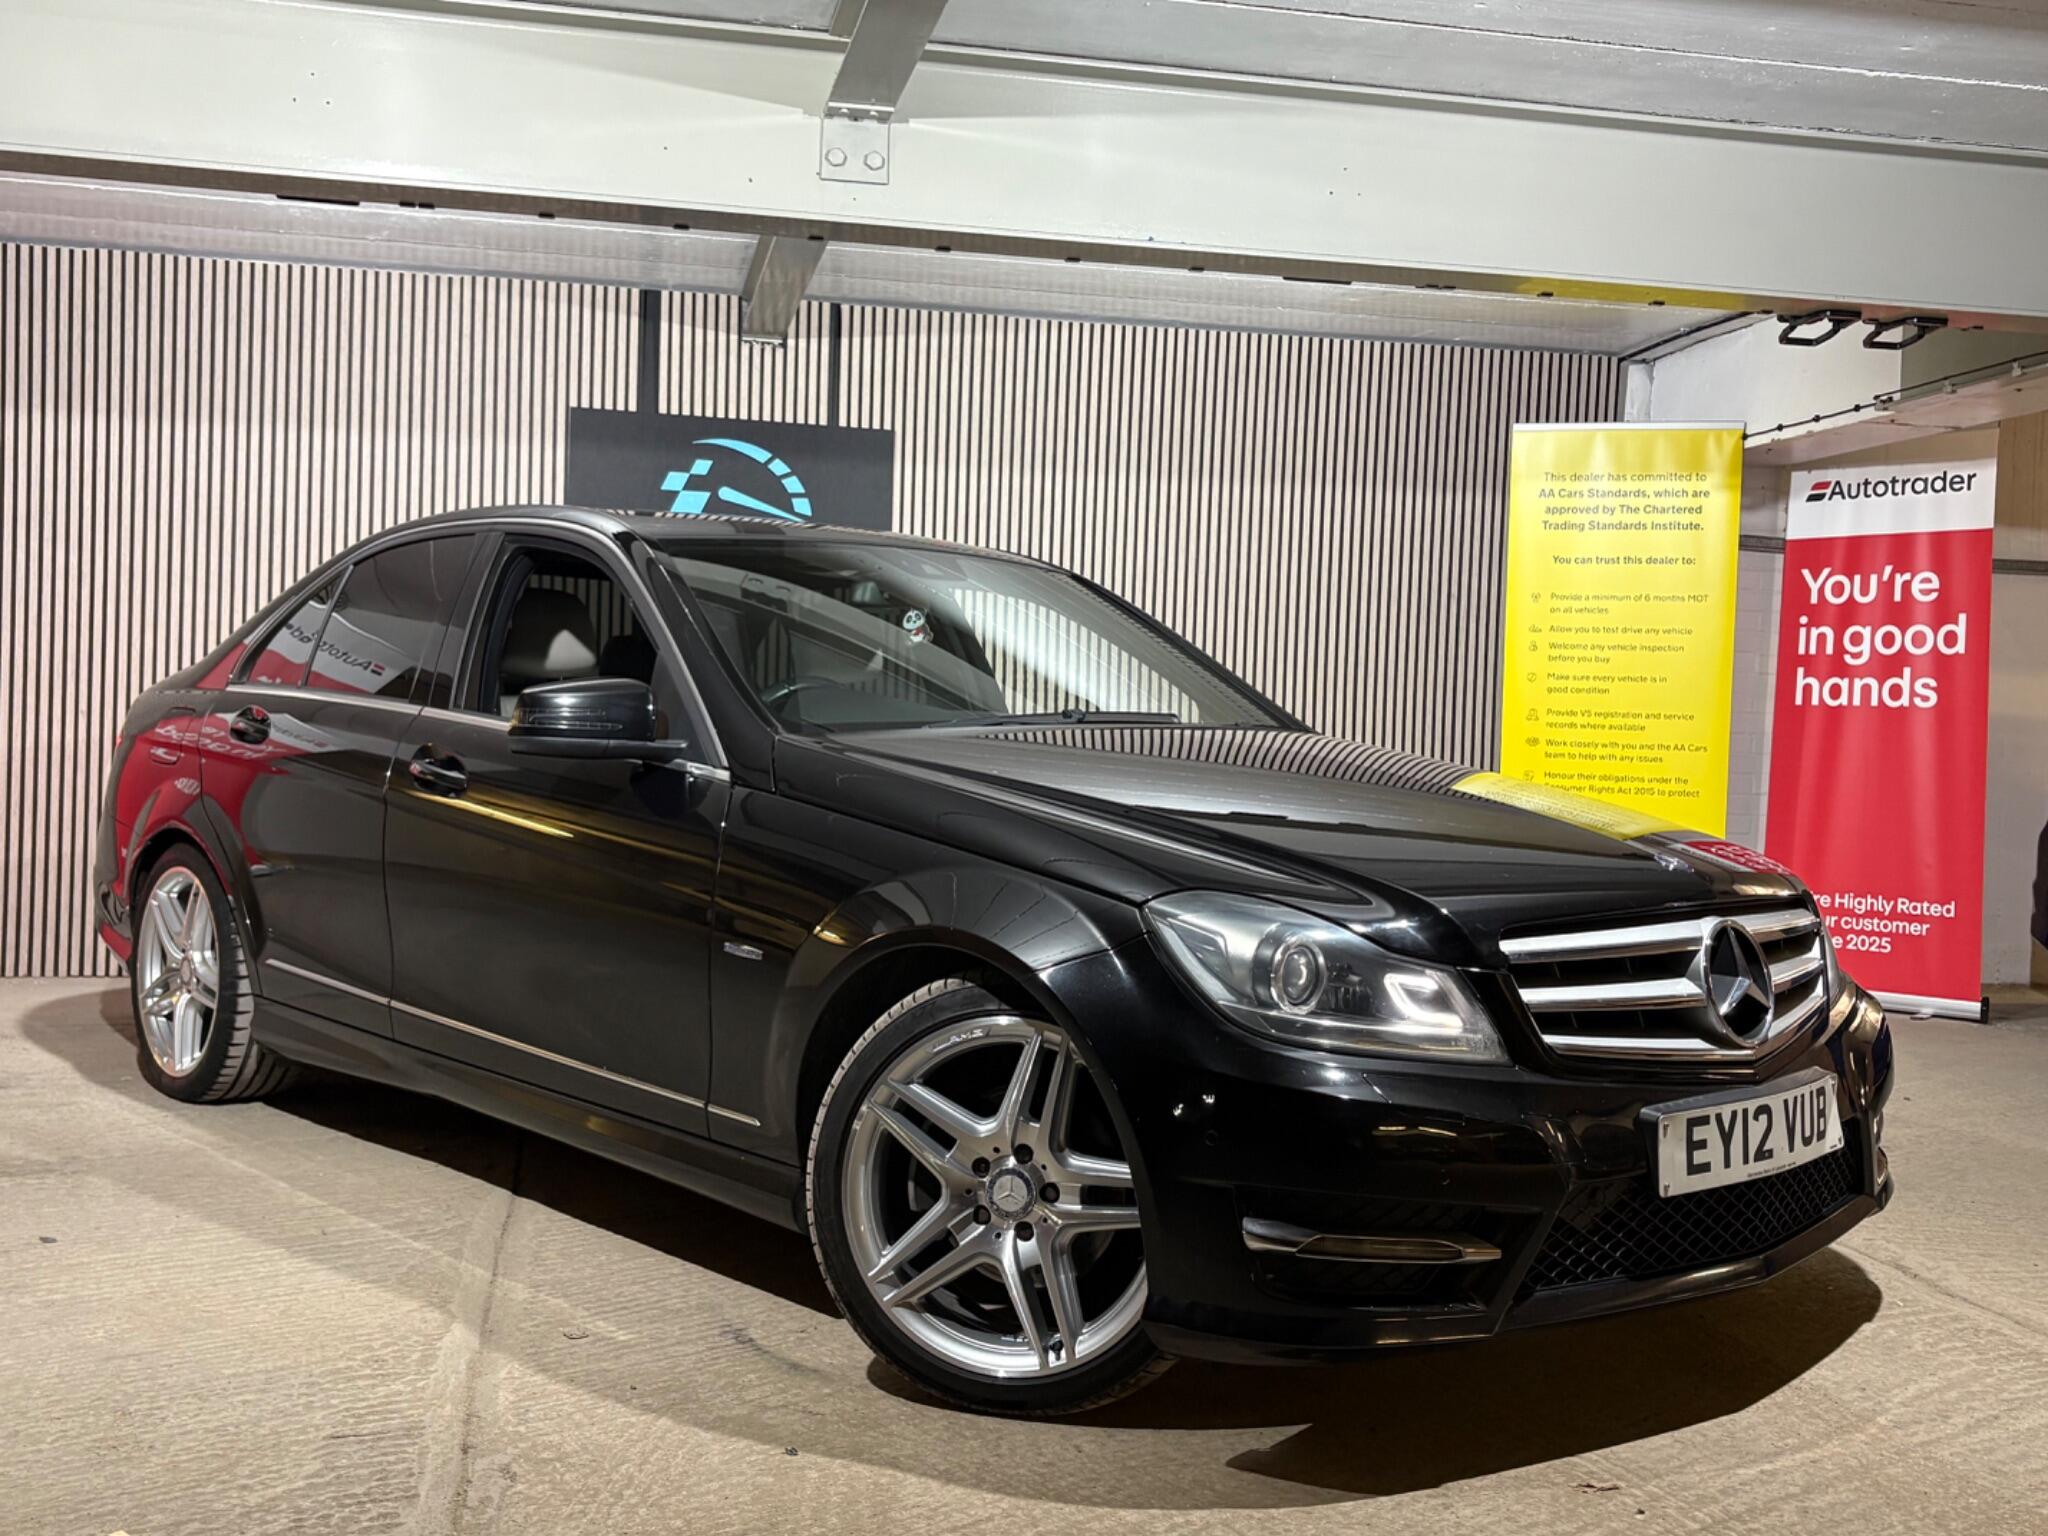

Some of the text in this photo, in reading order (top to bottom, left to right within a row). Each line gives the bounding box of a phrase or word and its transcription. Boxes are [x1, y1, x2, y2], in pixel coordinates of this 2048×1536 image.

[1544, 472, 1707, 482] This dealer has committed to
[1828, 471, 1976, 501] Autotrader
[1538, 488, 1710, 498] AA Cars Standards, which are
[1544, 504, 1702, 515] approved by The Chartered
[1542, 520, 1703, 531] Trading Standards Institute.
[1552, 555, 1571, 564] You
[1595, 555, 1619, 564] trust
[1623, 555, 1642, 564] this
[1645, 555, 1679, 564] dealer
[1681, 556, 1695, 564] to:
[1800, 565, 1940, 605] You're
[1797, 612, 1967, 666] in good
[1795, 667, 1938, 708] hands
[1835, 892, 1894, 915] Highly
[1897, 898, 1956, 918] Rated
[1841, 916, 1930, 936] customer
[1846, 934, 1892, 953] 2025
[1686, 1085, 1827, 1177] EY12 VUB
